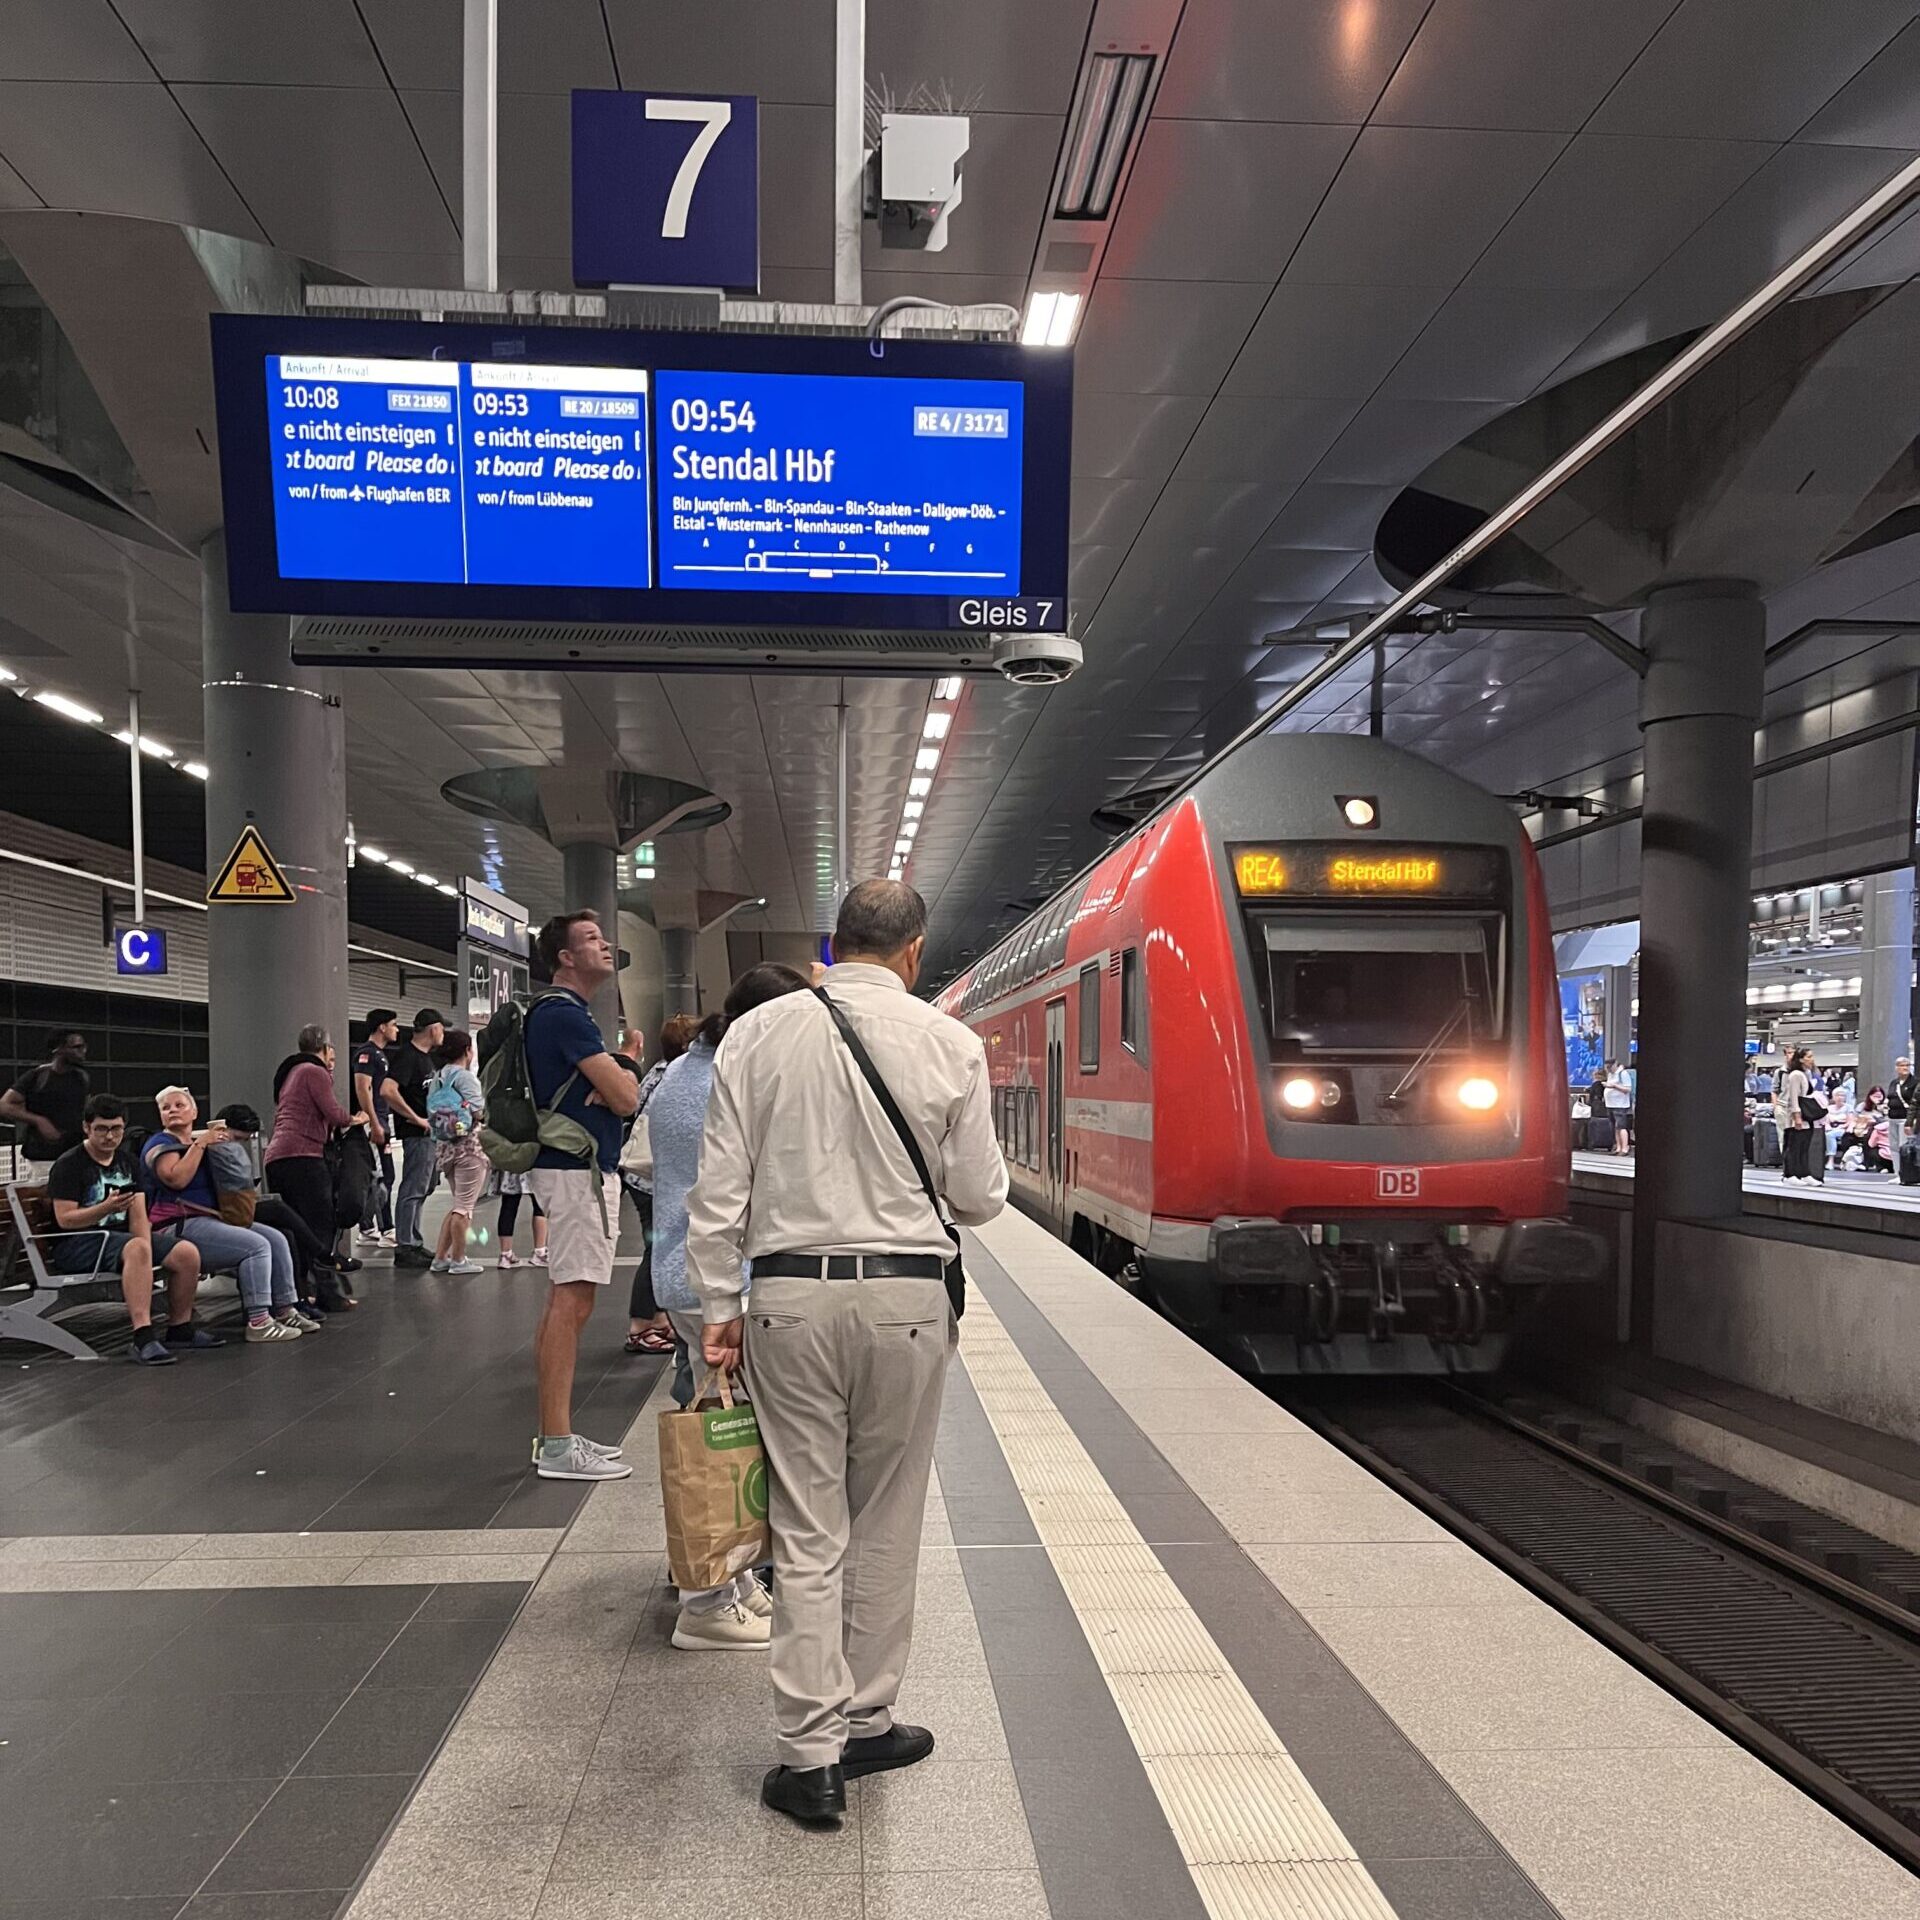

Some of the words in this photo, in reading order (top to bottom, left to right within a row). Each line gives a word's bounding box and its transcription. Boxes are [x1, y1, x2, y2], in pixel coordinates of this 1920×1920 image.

[645, 99, 731, 238] 7
[285, 362, 326, 375] Ankunft
[336, 364, 370, 377] Arrival
[283, 386, 339, 409] 10:08
[392, 394, 411, 407] FEX
[473, 393, 528, 416] 09:53
[564, 401, 577, 414] RE
[579, 401, 593, 414] 20
[602, 402, 635, 415] 18509
[671, 399, 756, 433] 09:54
[918, 412, 938, 431] RE
[940, 413, 951, 431] 4
[964, 413, 1005, 432] 3171
[299, 419, 343, 441] nicht
[345, 422, 436, 449] einsteigen
[489, 426, 532, 448] nicht
[534, 429, 623, 455] einsteigen
[304, 449, 355, 471] board
[365, 450, 423, 473] Please
[425, 453, 448, 474] do
[493, 455, 544, 477] board
[553, 456, 609, 479] Please
[611, 459, 634, 480] do
[672, 445, 778, 481] Stendal
[786, 448, 836, 482] Hbf
[288, 486, 310, 498] von
[320, 484, 348, 499] from
[366, 485, 425, 504] Flughafen
[426, 487, 451, 503] BER
[477, 492, 498, 505] von
[508, 490, 535, 505] from
[537, 491, 593, 508] Lübbenau
[673, 496, 692, 511] Bln
[693, 497, 753, 515] Jungfernh.
[764, 498, 834, 516] Bln-Spandau
[846, 500, 912, 517] Bln-Staaken
[923, 502, 996, 521] Dallgow-Döb.
[673, 515, 705, 531] Elstal
[716, 516, 783, 532] Wustermark
[794, 518, 863, 534] Nennhausen
[875, 520, 930, 536] Rathenow
[703, 537, 710, 548] A
[748, 538, 756, 549] B
[794, 539, 800, 550] C
[839, 541, 846, 551] D
[884, 541, 891, 552] E
[929, 542, 936, 553] F
[959, 599, 1028, 626] Gleis
[1036, 602, 1053, 626] 7
[1241, 855, 1284, 887] RE4
[1333, 859, 1401, 881] Stendal
[1404, 861, 1436, 881] Hbf
[121, 929, 150, 965] C
[1382, 1172, 1417, 1194] DB
